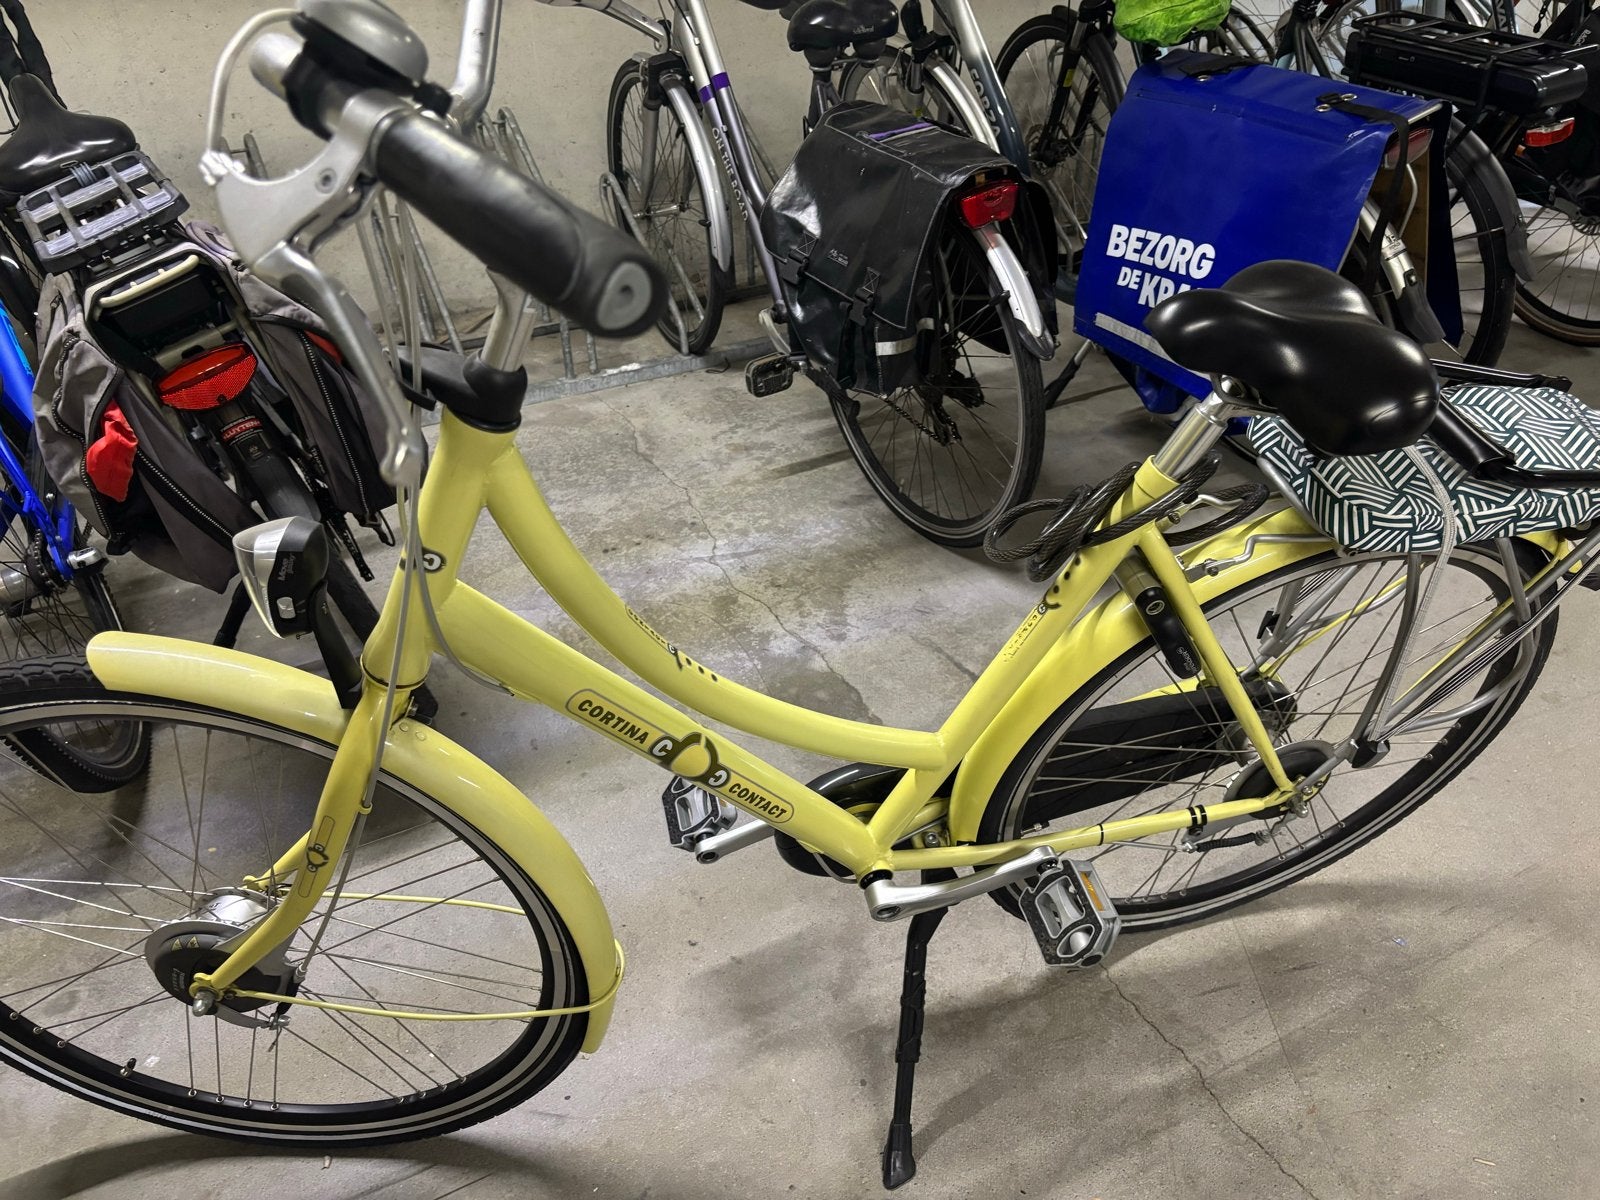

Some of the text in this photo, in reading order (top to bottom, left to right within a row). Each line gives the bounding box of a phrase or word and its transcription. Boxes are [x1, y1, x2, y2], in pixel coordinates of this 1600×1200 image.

[712, 127, 749, 221] ON THE ROAD
[1106, 224, 1216, 280] BEZORG
[1116, 266, 1143, 290] DE
[578, 699, 649, 745] CORTINA
[729, 783, 788, 819] CONTACT
